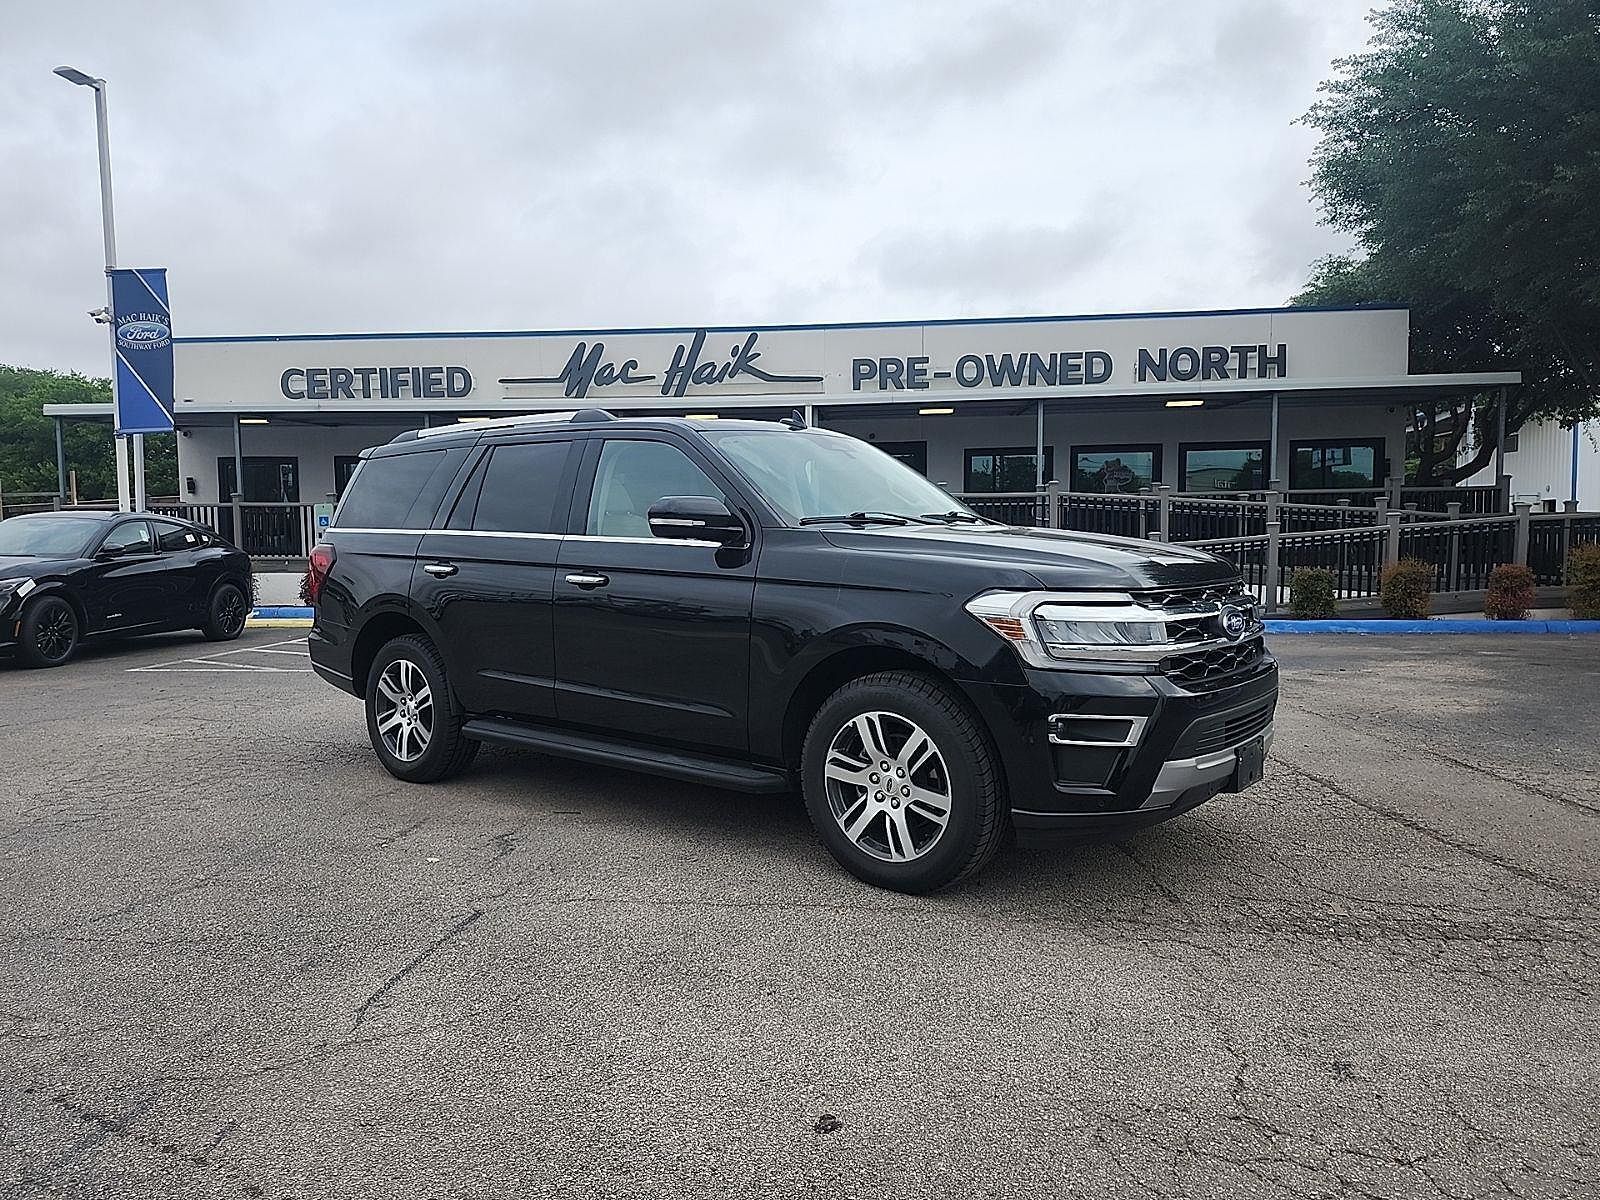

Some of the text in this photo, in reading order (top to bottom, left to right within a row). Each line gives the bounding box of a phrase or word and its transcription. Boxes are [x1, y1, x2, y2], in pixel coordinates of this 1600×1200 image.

[117, 312, 170, 326] MAC HAIK'S
[117, 338, 170, 350] SOUTHWAY FORD
[127, 325, 160, 340] Ford
[498, 329, 823, 398] Mac Haik
[852, 343, 1288, 391] PRE-OWNED NORTH
[281, 366, 473, 400] CERTIFIED
